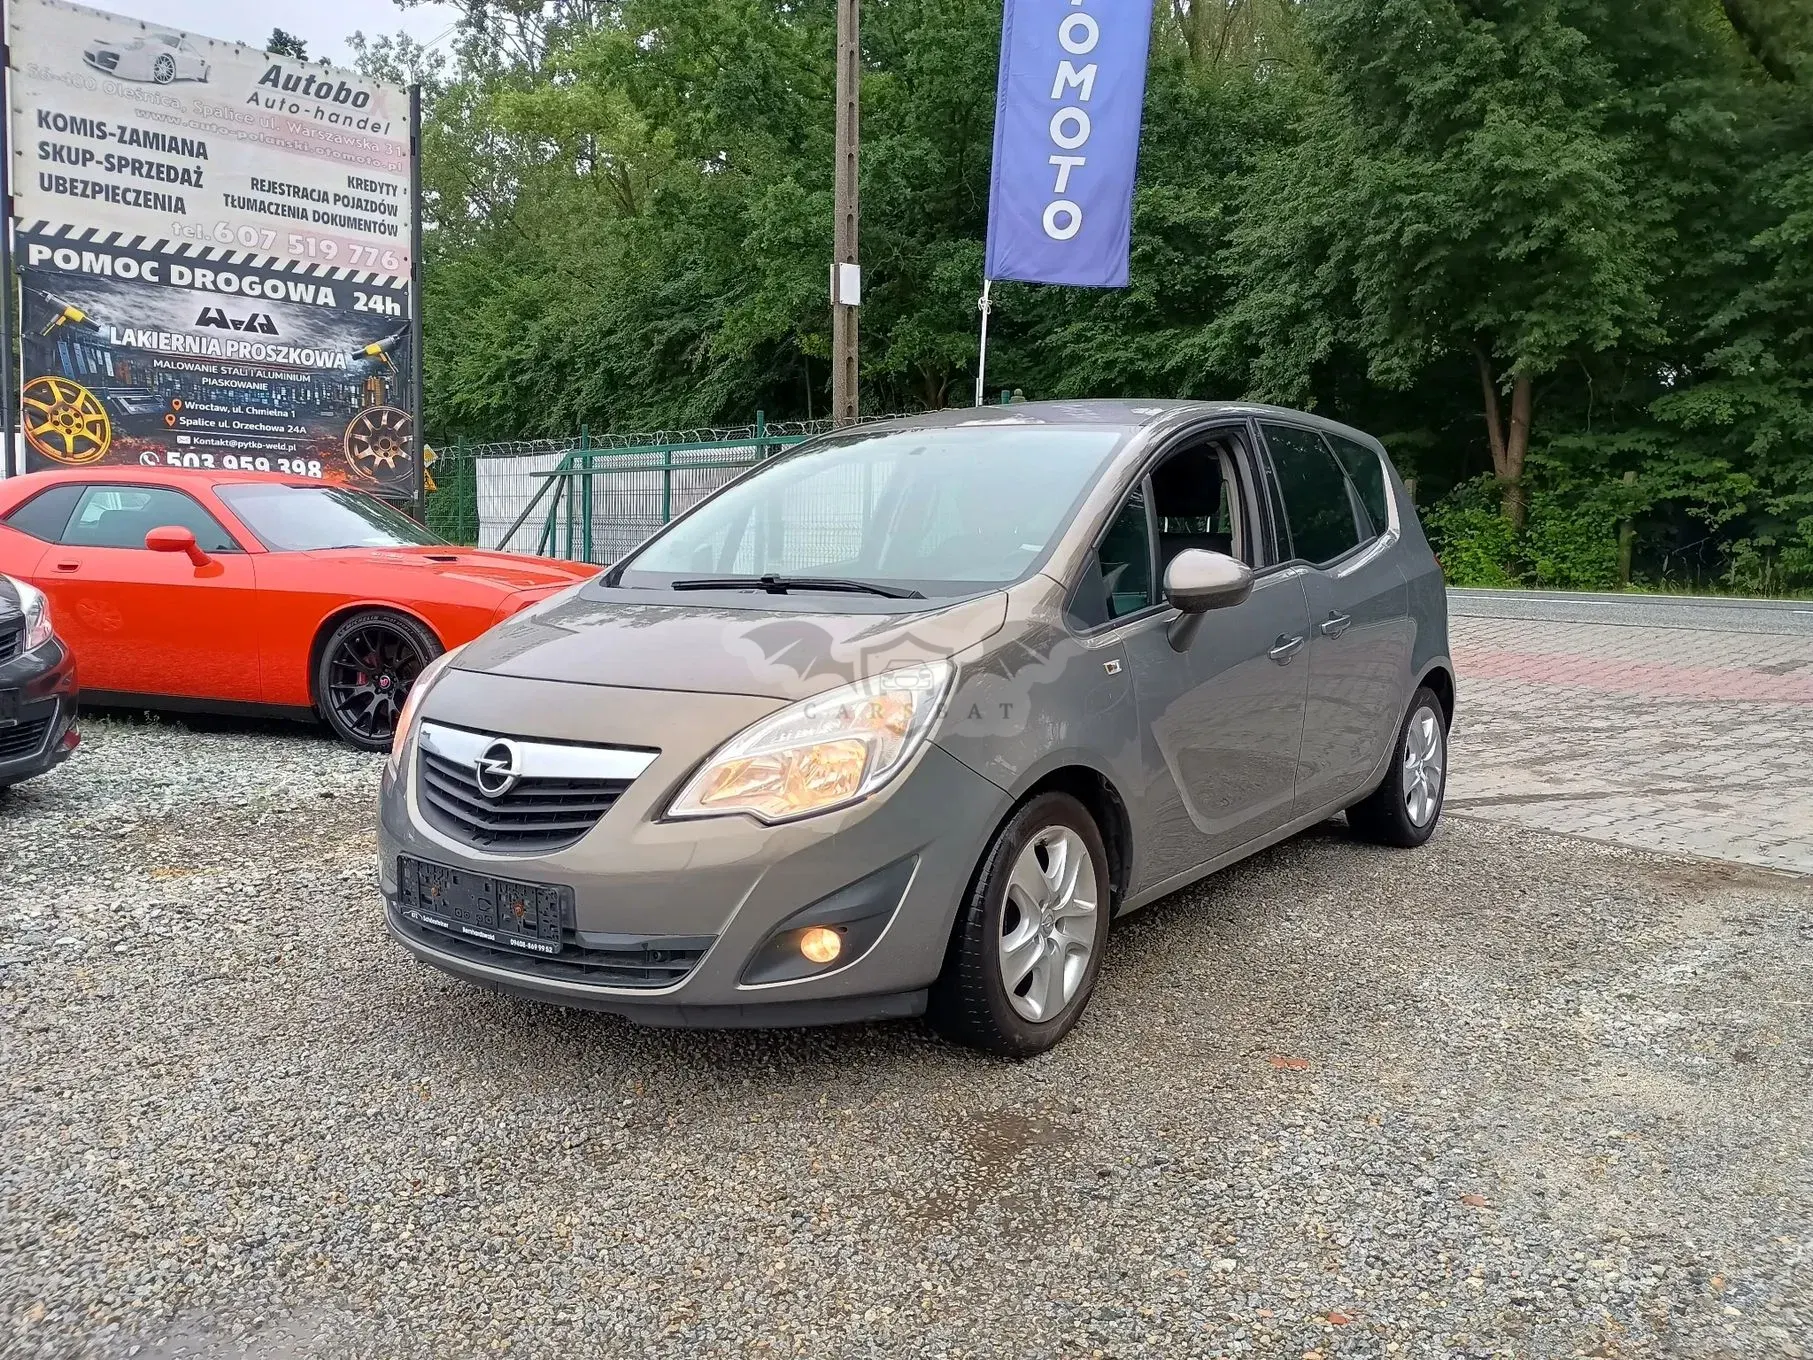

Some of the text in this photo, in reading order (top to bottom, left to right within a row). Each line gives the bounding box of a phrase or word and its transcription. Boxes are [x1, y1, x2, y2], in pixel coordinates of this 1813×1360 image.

[36, 108, 208, 160] KOMIS-ZAMIANA
[102, 80, 187, 113] Oleśnica,
[193, 100, 255, 124] Spalice
[259, 116, 280, 131] ul.
[287, 120, 379, 152] Warszawska
[385, 142, 401, 158] 31
[246, 92, 391, 135] Auto-handel
[1042, 0, 1099, 240] OMOTO
[134, 108, 402, 172] www.auto-polanski.otomoto.pl
[37, 140, 203, 188] SKUP-SPRZEDAŻ
[38, 171, 186, 214] UBEZPIECZENIA
[250, 177, 398, 217] REJESTRACJA POJAZDÓW
[347, 175, 398, 197] KREDYTY
[223, 193, 398, 237] TŁUMACZENIA DOKUMENTÓW
[287, 233, 338, 261] 519
[349, 244, 400, 271] 776
[28, 243, 401, 317] POMOC DROGOWA 24h
[109, 326, 347, 369] LAKIERNIA PROSZKOWA
[153, 359, 218, 374] MALOWANIE
[221, 366, 248, 377] STALI
[256, 370, 311, 383] ALUMINIUM
[202, 377, 268, 391] PIASKOWANIE
[179, 416, 307, 434] Spalice ul. Orzechowa 24A
[232, 404, 244, 414] ul.
[246, 406, 289, 418] Chmielna
[291, 410, 296, 418] 1
